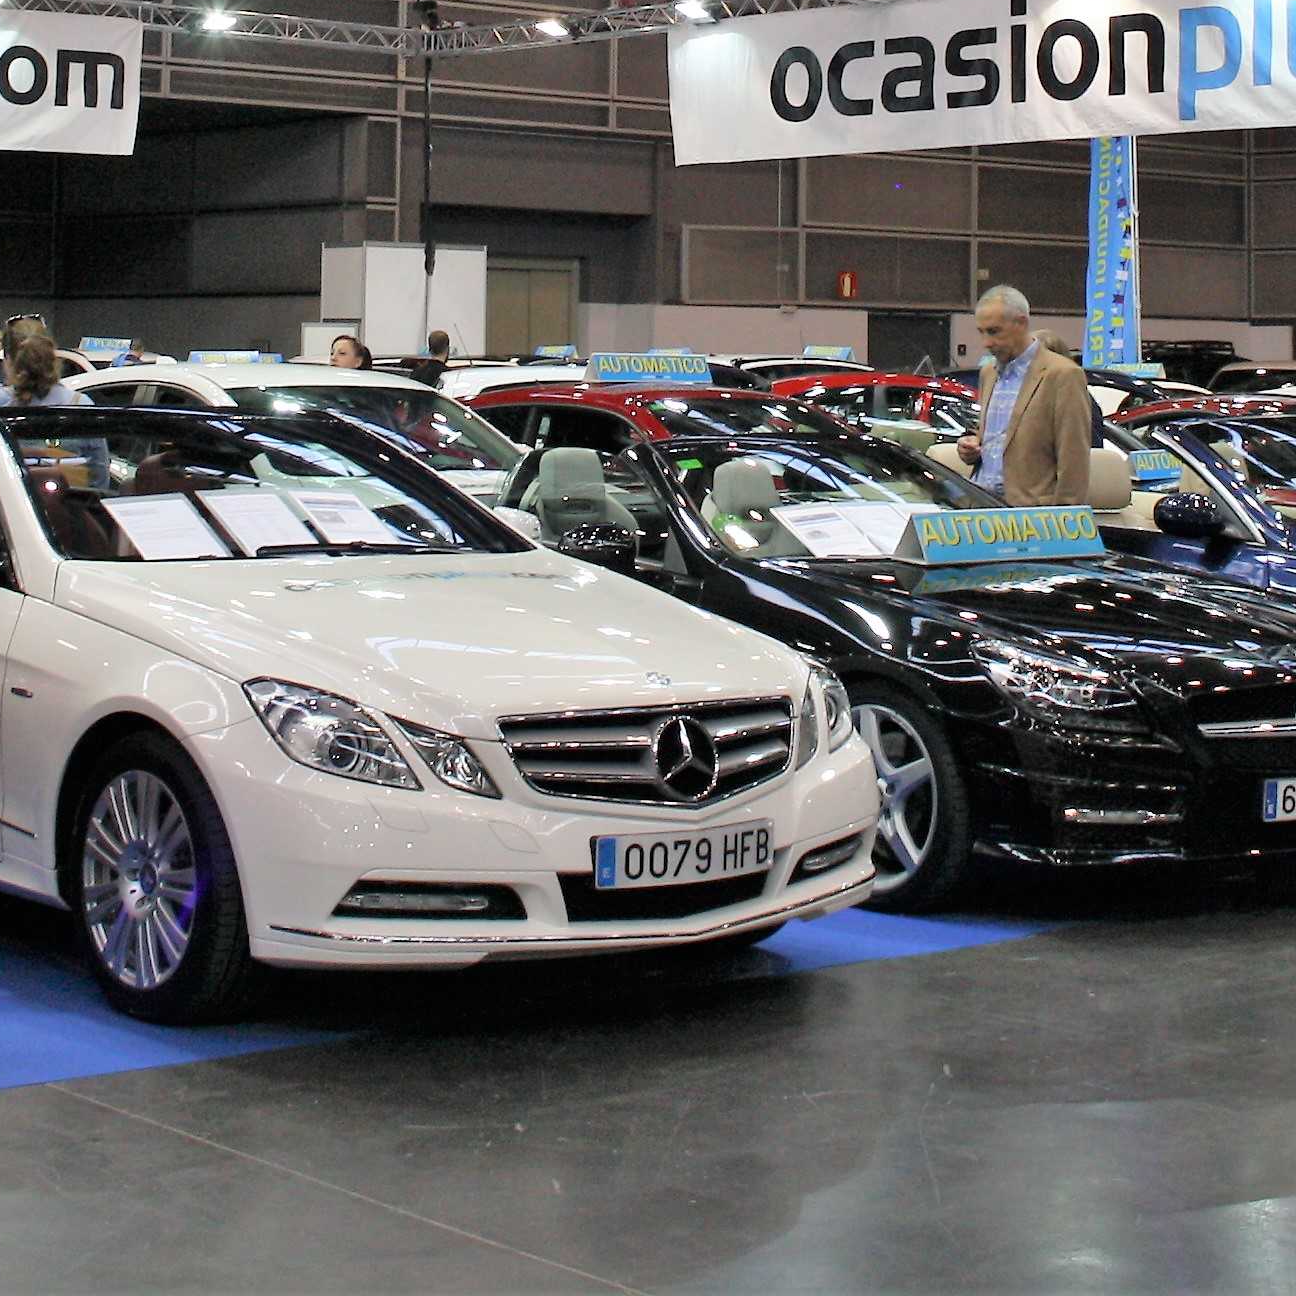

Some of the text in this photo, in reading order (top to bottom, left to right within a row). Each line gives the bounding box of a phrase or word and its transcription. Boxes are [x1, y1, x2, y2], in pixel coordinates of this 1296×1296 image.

[1135, 452, 1182, 470] AUTOM
[921, 512, 1098, 546] AUTOMATICO
[624, 828, 769, 880] 0079 HFB
